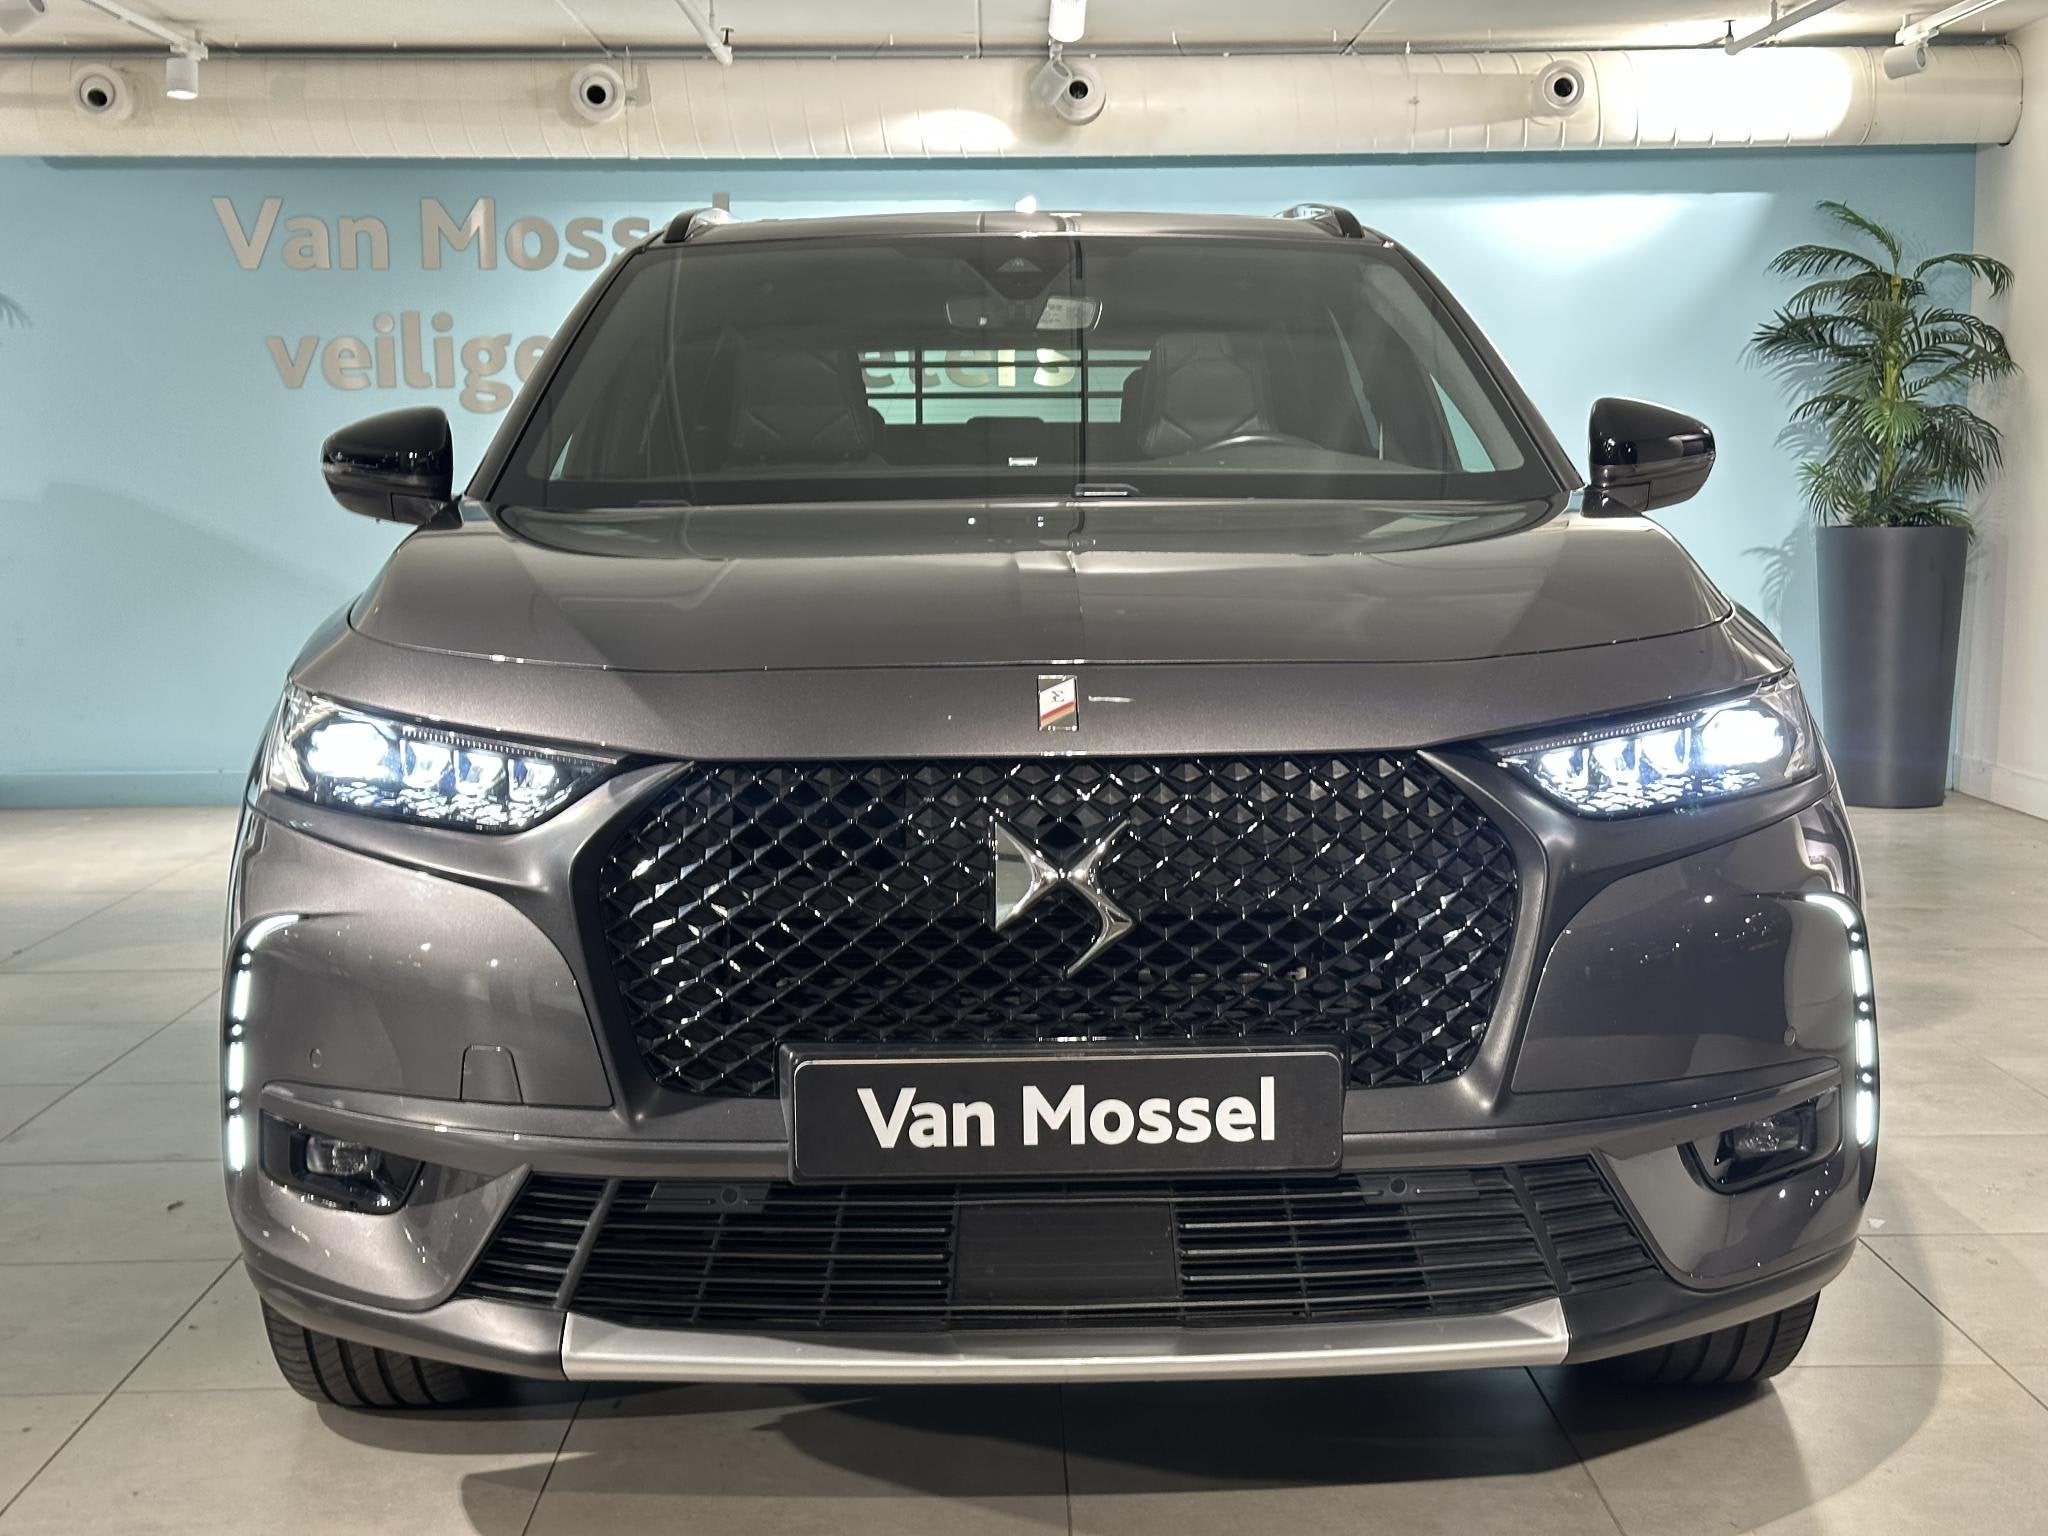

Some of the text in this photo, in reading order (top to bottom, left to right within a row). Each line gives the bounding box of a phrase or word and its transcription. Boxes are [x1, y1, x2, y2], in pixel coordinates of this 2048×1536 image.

[211, 196, 390, 271] Van
[265, 310, 552, 413] veilige
[856, 1076, 1276, 1149] Van Mossel
